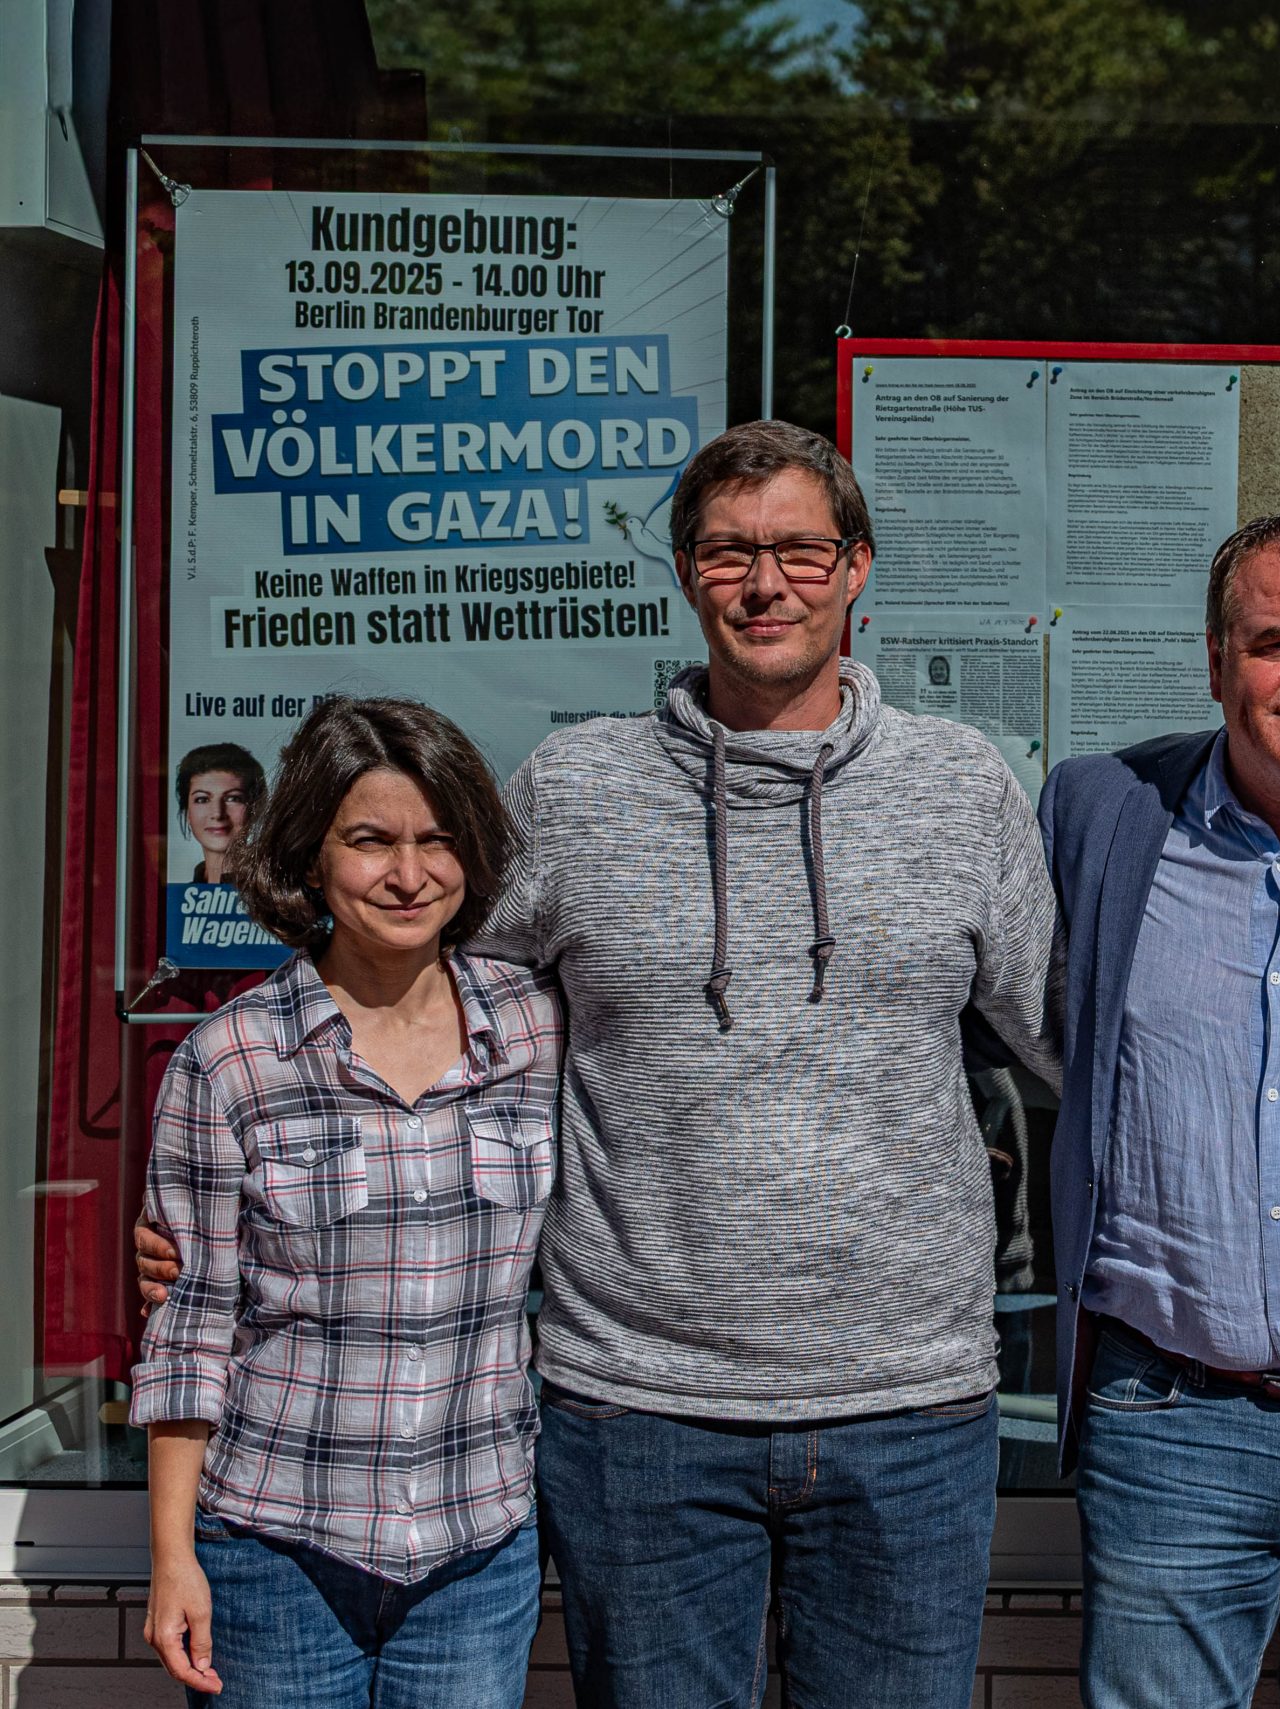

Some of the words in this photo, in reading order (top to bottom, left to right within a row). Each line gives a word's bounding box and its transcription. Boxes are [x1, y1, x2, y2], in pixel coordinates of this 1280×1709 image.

[311, 206, 576, 261] Kundgebung:
[285, 260, 443, 295] 13.09.2025
[472, 263, 548, 297] 14.00
[557, 265, 606, 299] Uhr
[295, 300, 366, 330] Berlin
[373, 302, 559, 336] Brandenburger
[566, 306, 604, 333] Tor
[189, 316, 201, 380] Ruppichteroth
[258, 349, 506, 404] STOPPT
[528, 345, 660, 396] DEN
[189, 382, 198, 411] 53809
[875, 405, 942, 413] Rietzgartenstraße
[876, 395, 901, 403] Antrag
[914, 394, 928, 402] den
[930, 394, 942, 402] OB
[957, 395, 995, 404] Sanierung
[189, 413, 199, 422] 6,
[875, 415, 935, 423] Vereinsgelände)
[188, 424, 199, 486] Schmelztalstr.
[222, 409, 691, 478] VÖLKERMORD
[187, 487, 199, 526] Kemper,
[290, 493, 361, 545] IN
[386, 487, 583, 543] GAZA!
[187, 527, 196, 537] F.
[254, 568, 323, 599] Keine
[330, 567, 416, 597] Waffen
[424, 564, 448, 594] in
[455, 560, 636, 595] Kriegsgebiete!
[224, 606, 356, 649] Frieden
[367, 602, 451, 645] statt
[461, 596, 669, 643] Wettrüsten!
[880, 637, 937, 645] BSW-Ratsherr
[938, 637, 973, 646] kritisiert
[975, 637, 1038, 646] Praxis-Standort
[185, 692, 226, 717] Live
[232, 694, 265, 718] auf
[271, 694, 306, 718] der
